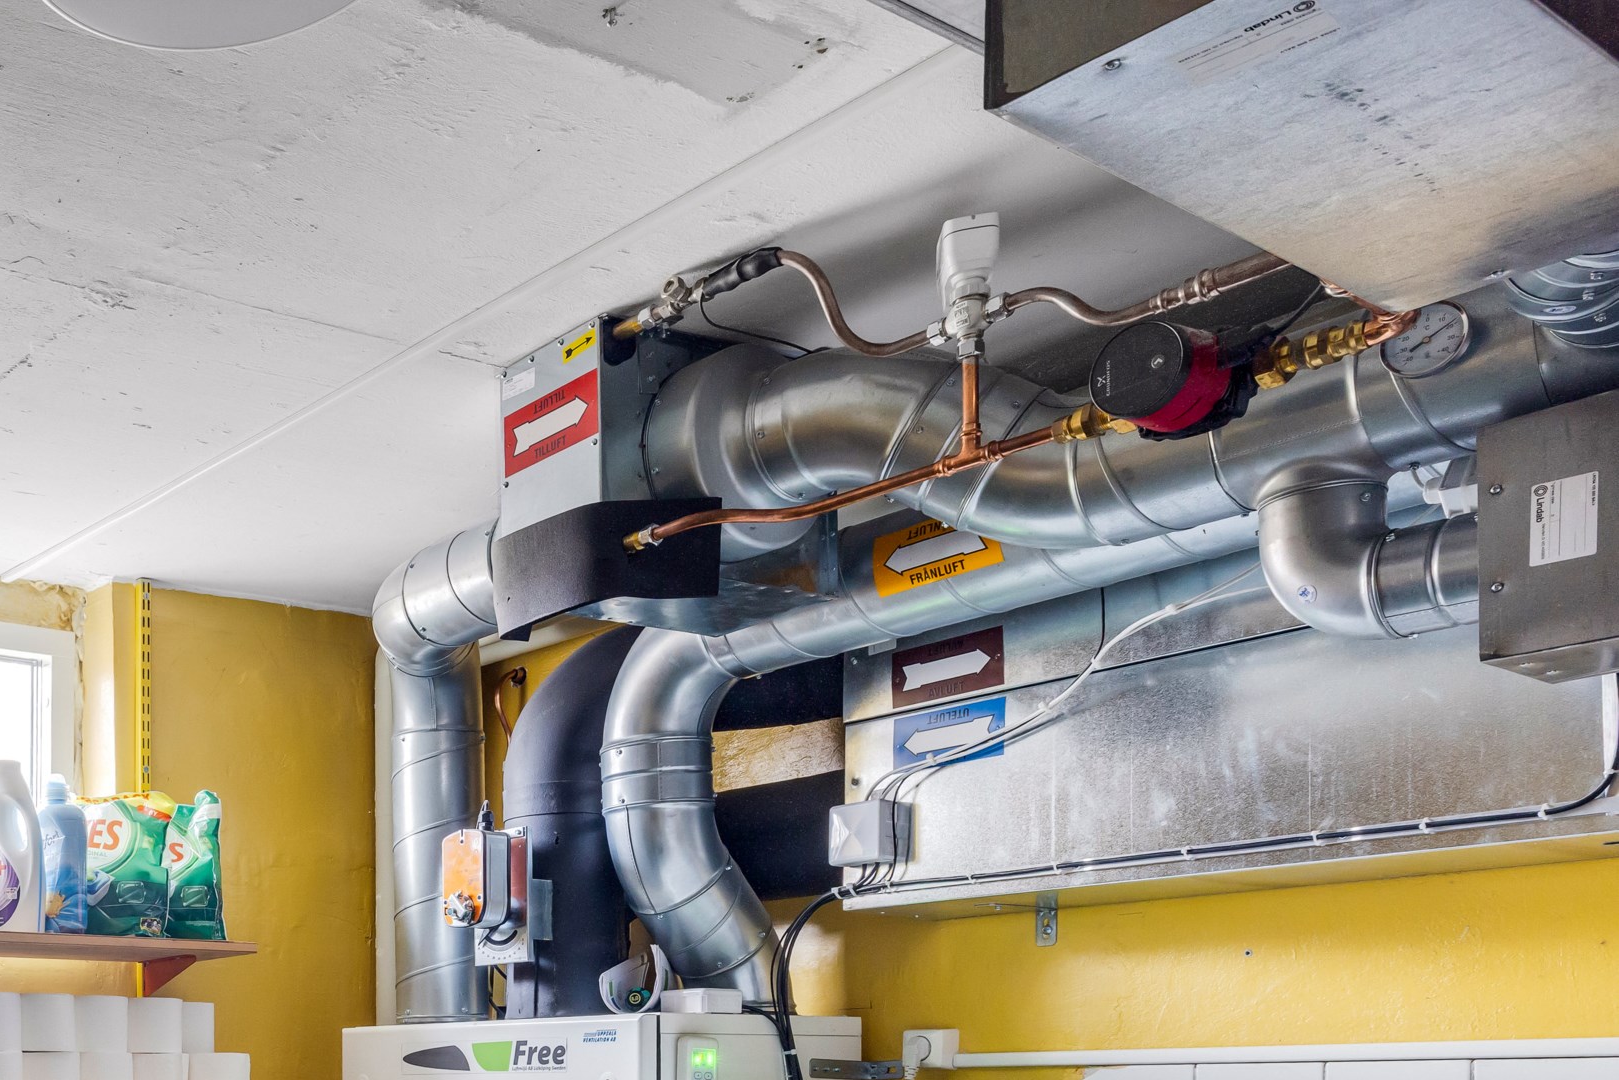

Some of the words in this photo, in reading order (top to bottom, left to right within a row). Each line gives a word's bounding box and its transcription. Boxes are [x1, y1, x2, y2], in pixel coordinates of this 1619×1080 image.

[1244, 10, 1292, 33] Lindab
[533, 390, 565, 415] TILLUFT
[534, 435, 566, 459] TILLUFT
[1536, 497, 1544, 523] Lindab
[907, 521, 942, 540] NLUFT
[909, 559, 965, 585] FRÅNLUFT
[927, 708, 969, 724] UTELUFT
[513, 1040, 566, 1065] Free
